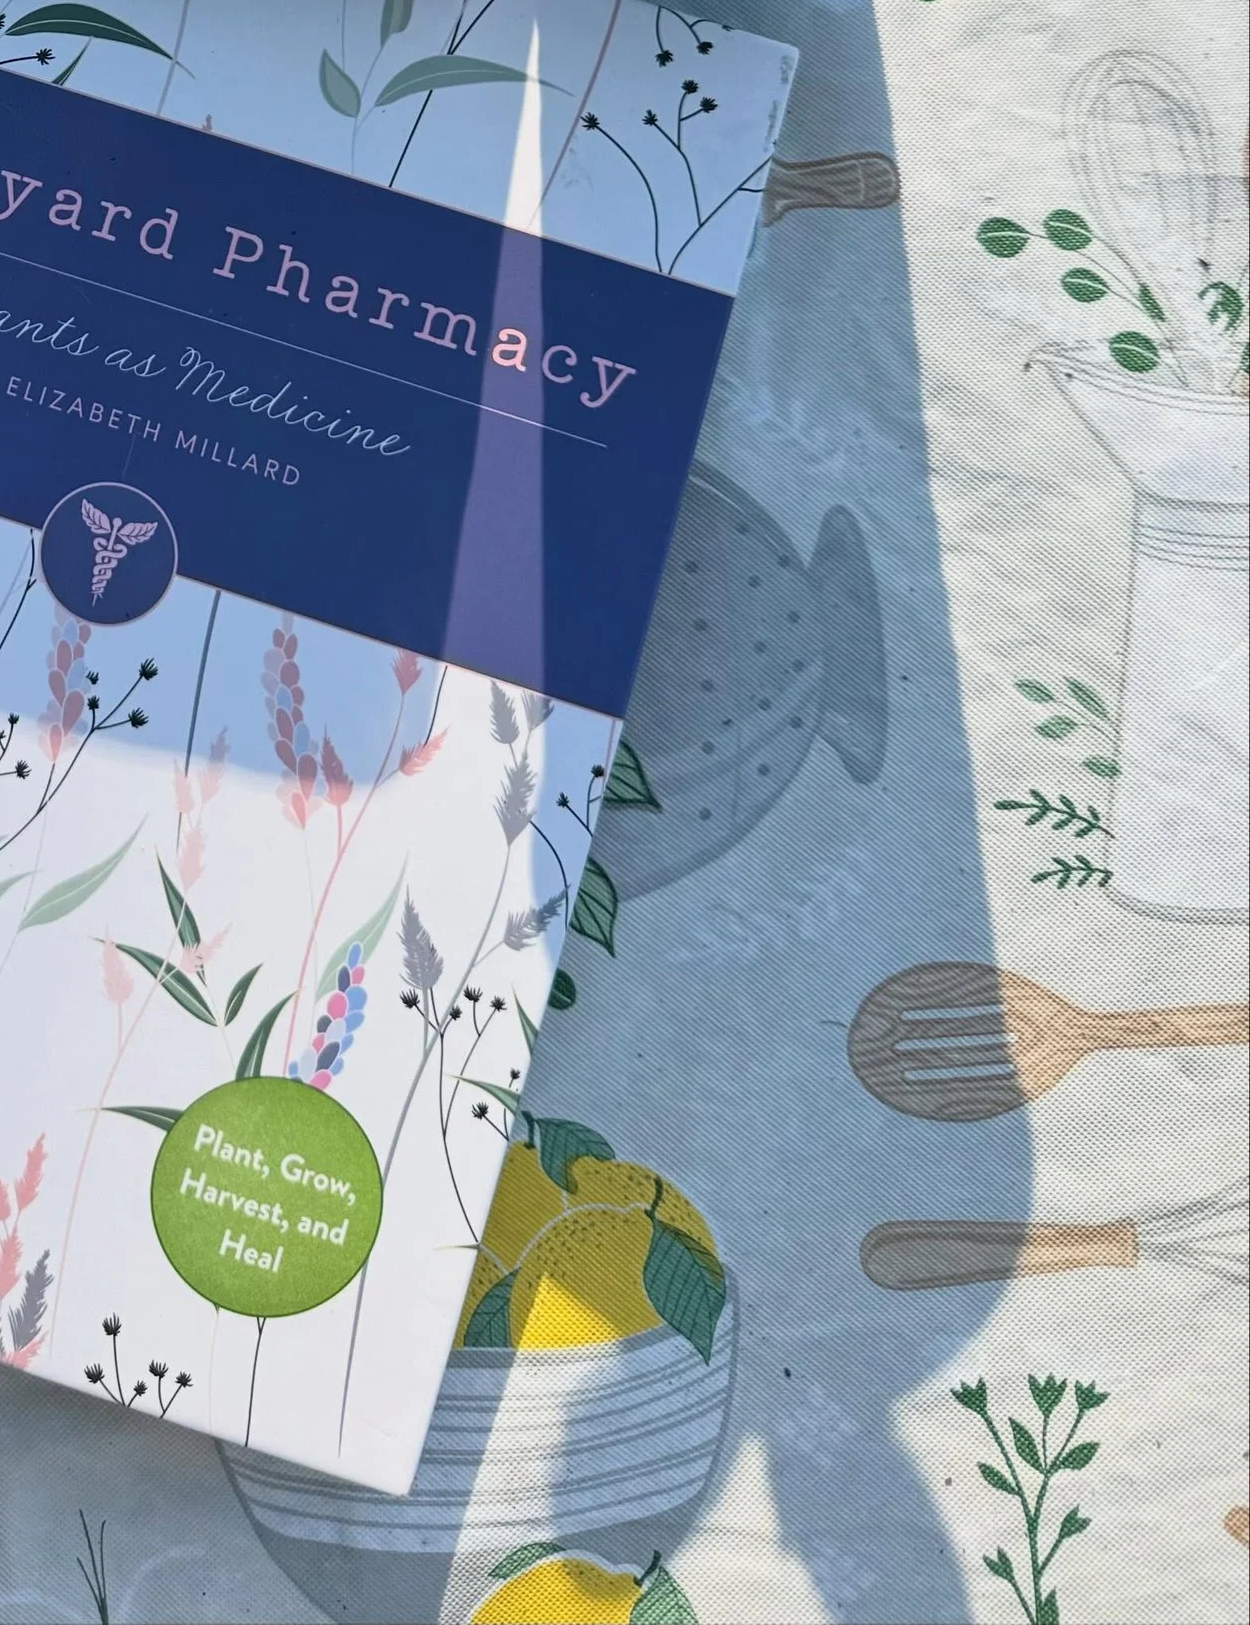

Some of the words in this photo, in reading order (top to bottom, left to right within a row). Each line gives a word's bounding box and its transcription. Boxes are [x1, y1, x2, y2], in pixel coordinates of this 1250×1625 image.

[213, 225, 637, 410] Pharmacy
[5, 376, 161, 443] ELIZABETH
[173, 429, 301, 486] MILLARD
[104, 346, 166, 378] as
[175, 345, 412, 457] Medicine
[179, 1167, 289, 1233] Harvest,
[296, 1218, 350, 1247] and
[192, 1123, 270, 1179] Plant,
[280, 1153, 356, 1207] Grow,
[218, 1228, 284, 1273] Heal
